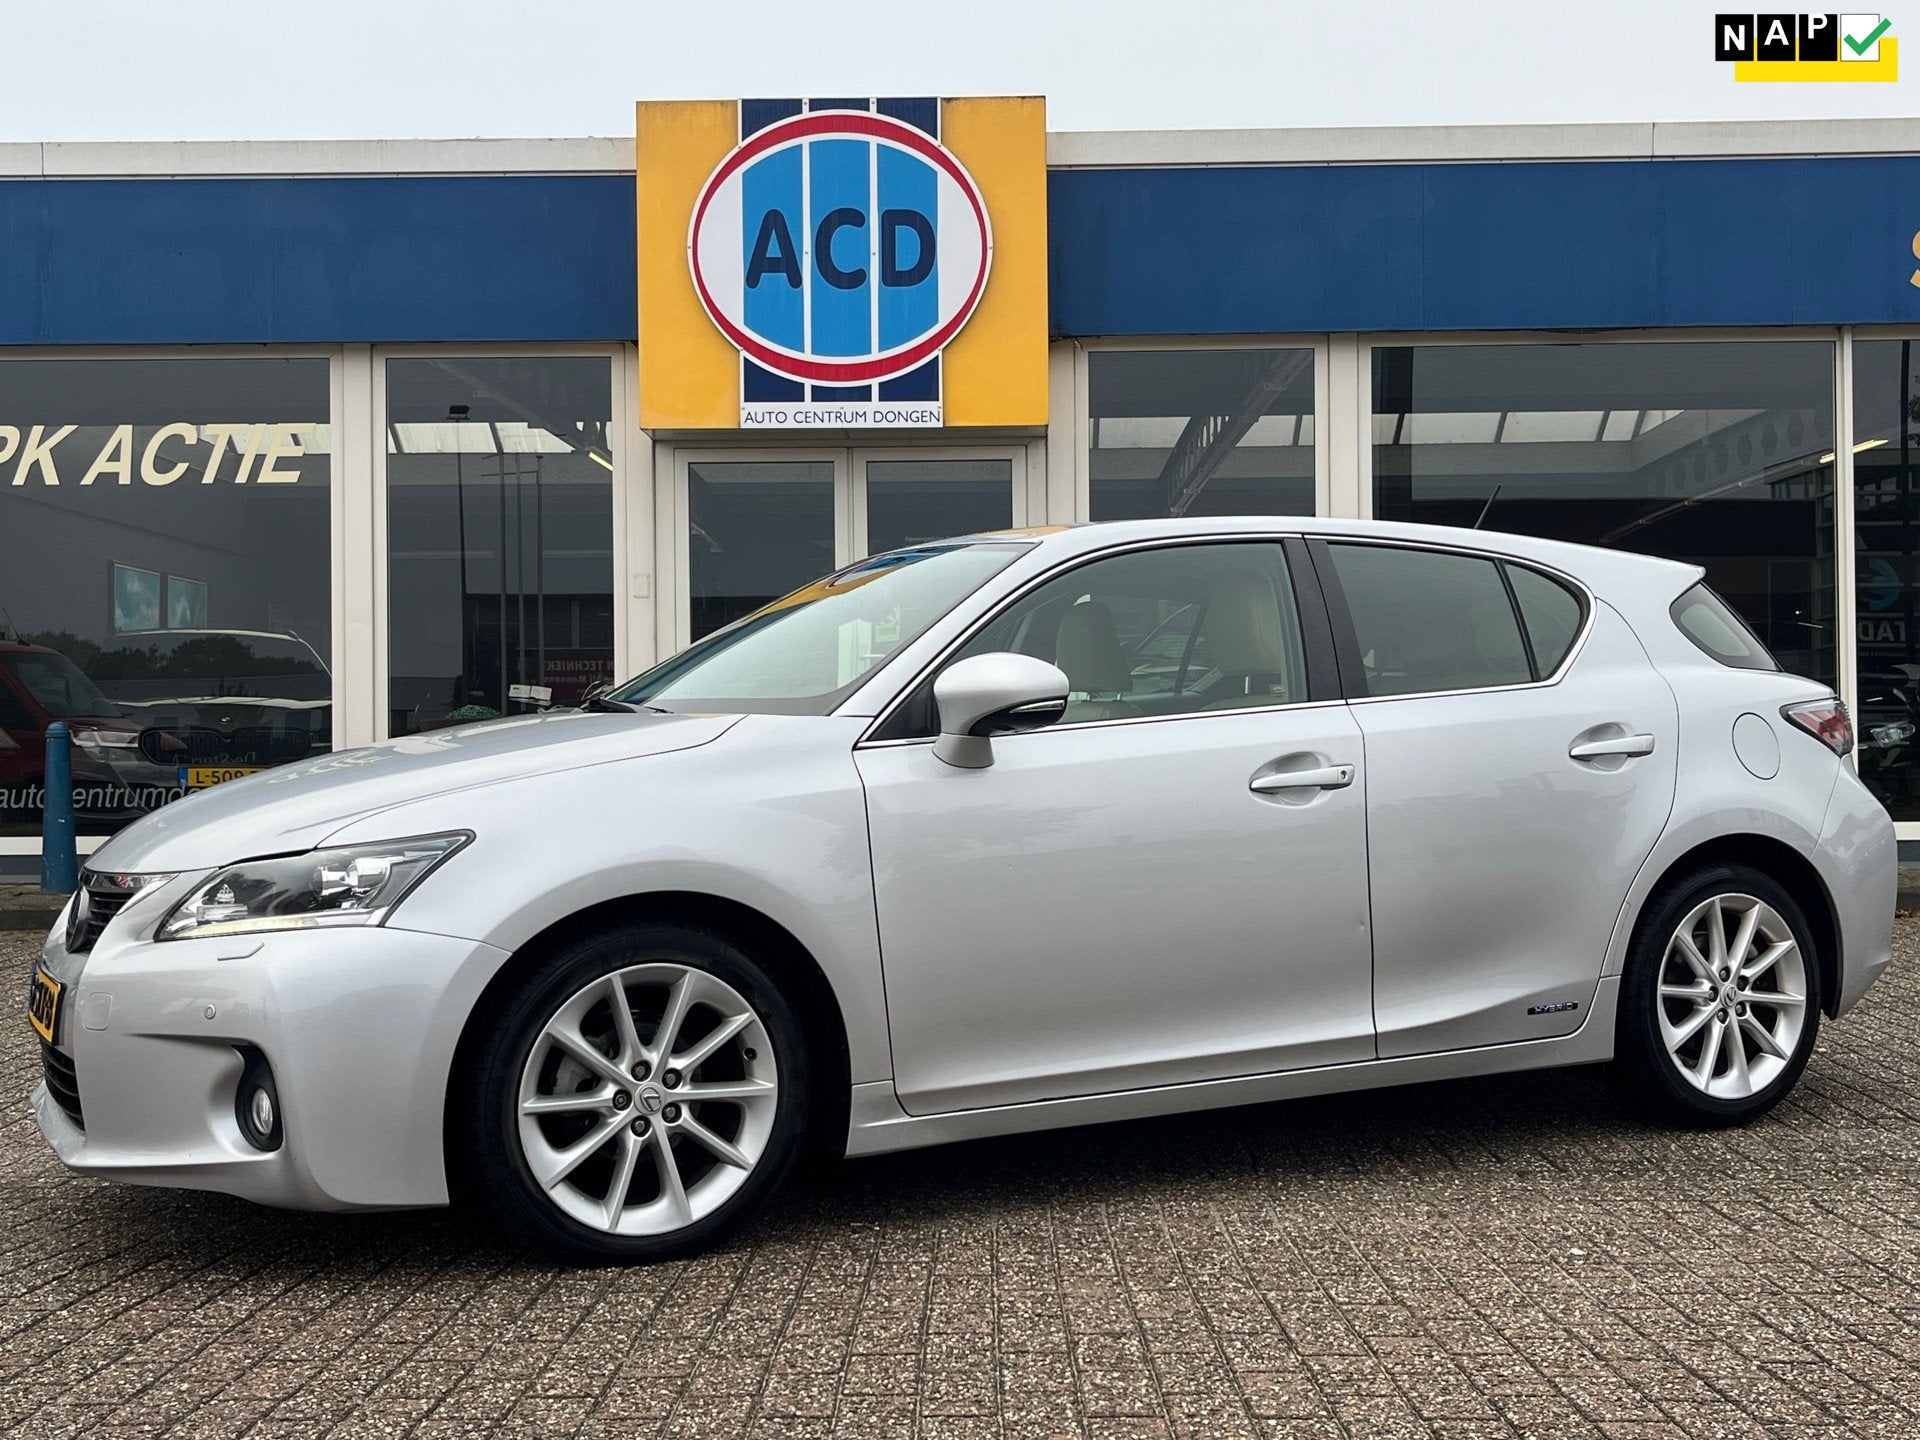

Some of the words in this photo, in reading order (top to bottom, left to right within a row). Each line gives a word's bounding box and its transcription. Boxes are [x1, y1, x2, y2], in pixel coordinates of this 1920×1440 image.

[745, 206, 936, 290] ACD
[744, 411, 788, 424] AUTO
[793, 411, 867, 424] CENTRUM
[873, 410, 941, 423] DONGEN
[79, 422, 317, 486] ACTIE
[1534, 1002, 1574, 1014] HYBRID
